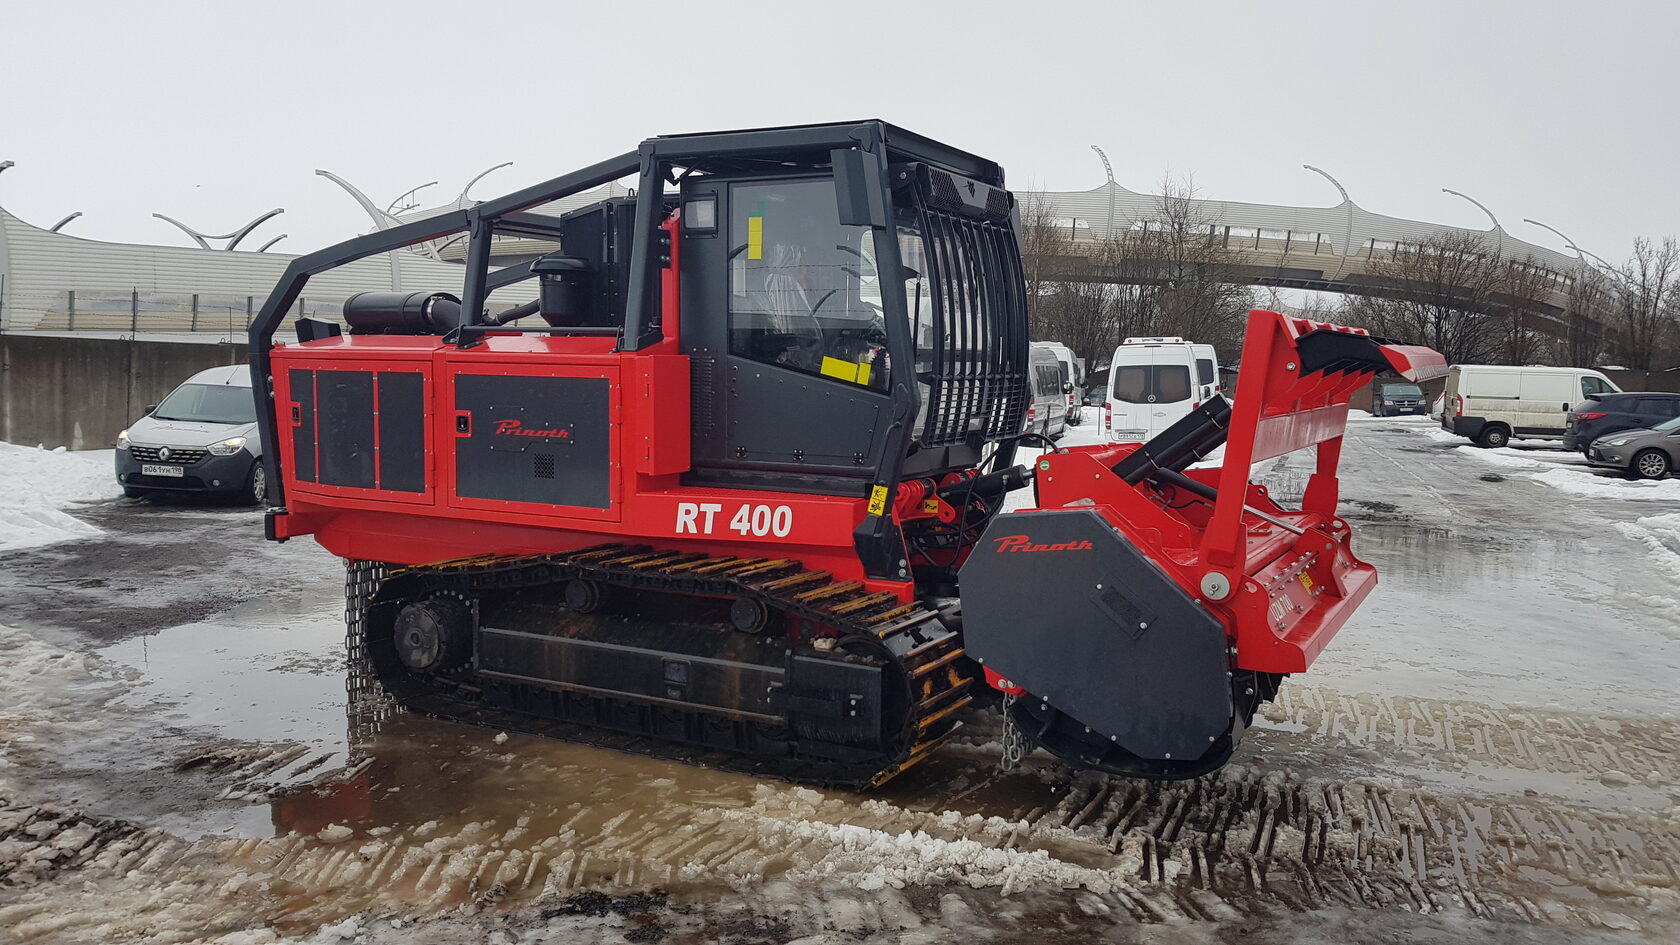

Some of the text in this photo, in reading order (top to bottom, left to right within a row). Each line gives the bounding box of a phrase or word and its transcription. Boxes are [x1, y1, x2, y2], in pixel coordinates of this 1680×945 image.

[675, 502, 793, 538] RT 400
[993, 535, 1094, 553] Prinoth
